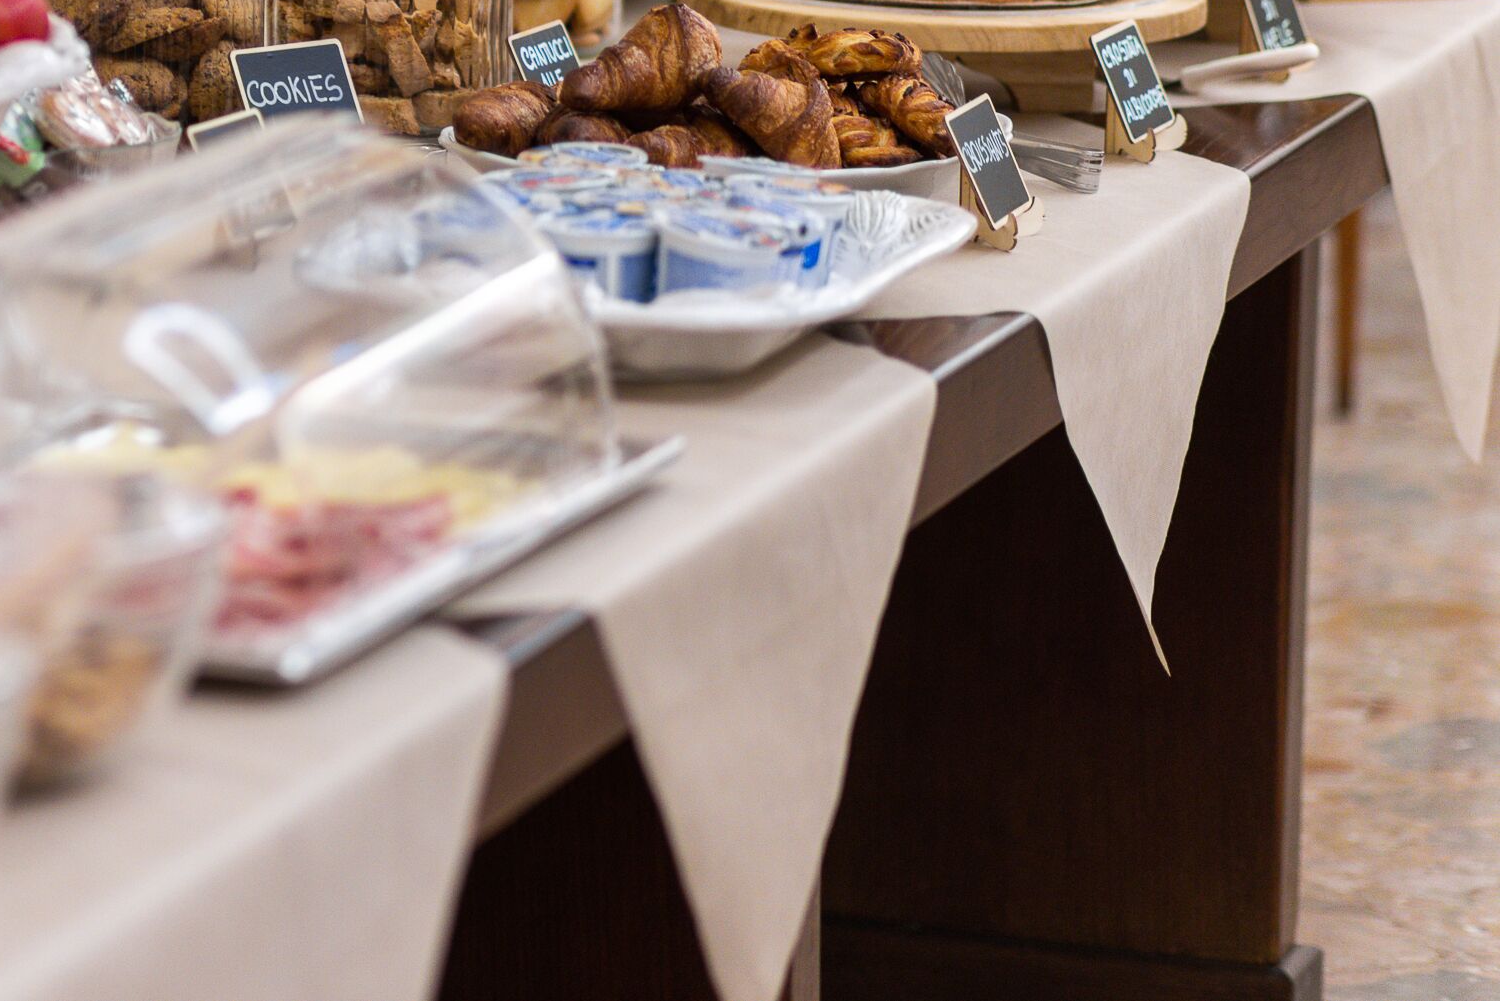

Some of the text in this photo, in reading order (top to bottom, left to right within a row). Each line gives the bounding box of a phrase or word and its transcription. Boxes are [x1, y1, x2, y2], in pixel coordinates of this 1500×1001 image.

[520, 35, 573, 71] CANTUCCI
[1101, 35, 1145, 69] CROSTATA
[246, 74, 343, 108] COOKIES
[962, 128, 1010, 173] CROISSANTS
